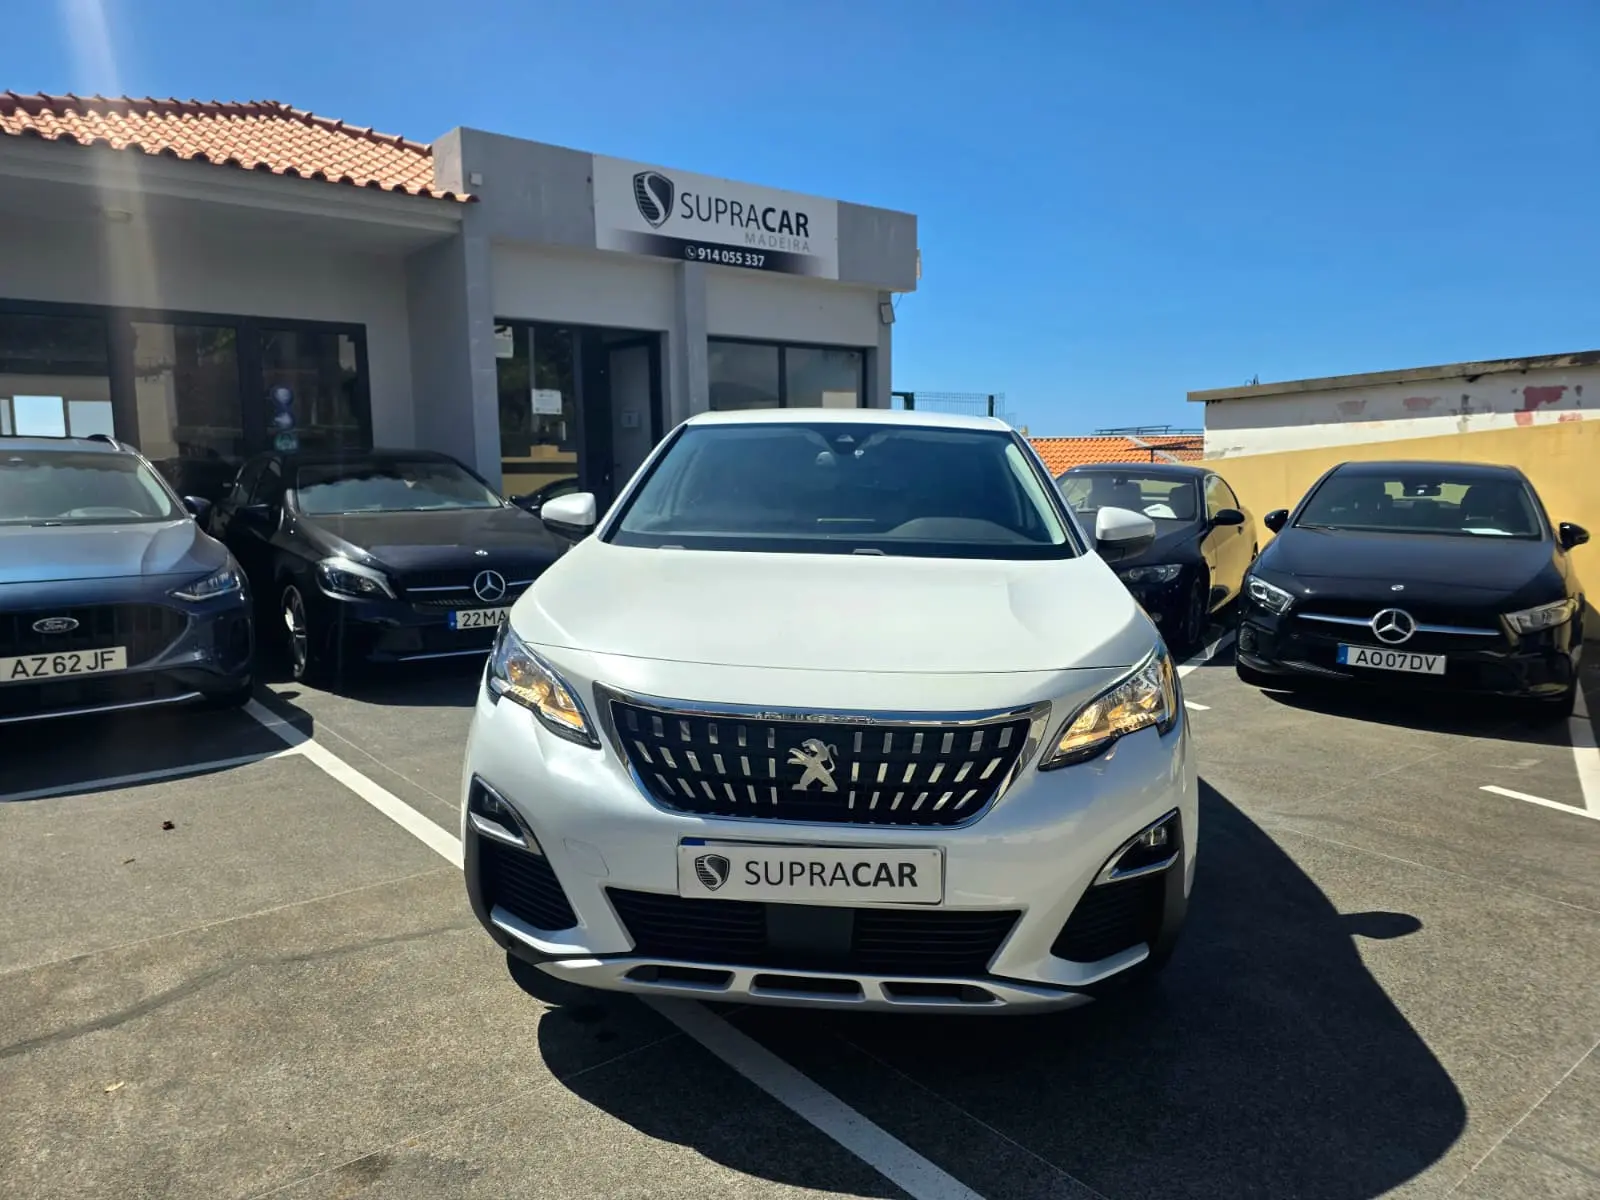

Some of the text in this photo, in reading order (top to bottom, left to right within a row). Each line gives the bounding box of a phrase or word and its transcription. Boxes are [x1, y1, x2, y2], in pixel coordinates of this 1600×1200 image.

[680, 192, 809, 238] SUPRACAR
[744, 232, 811, 253] MADEIRA
[698, 247, 765, 267] 914 055 337
[744, 860, 918, 888] SUPRACAR
